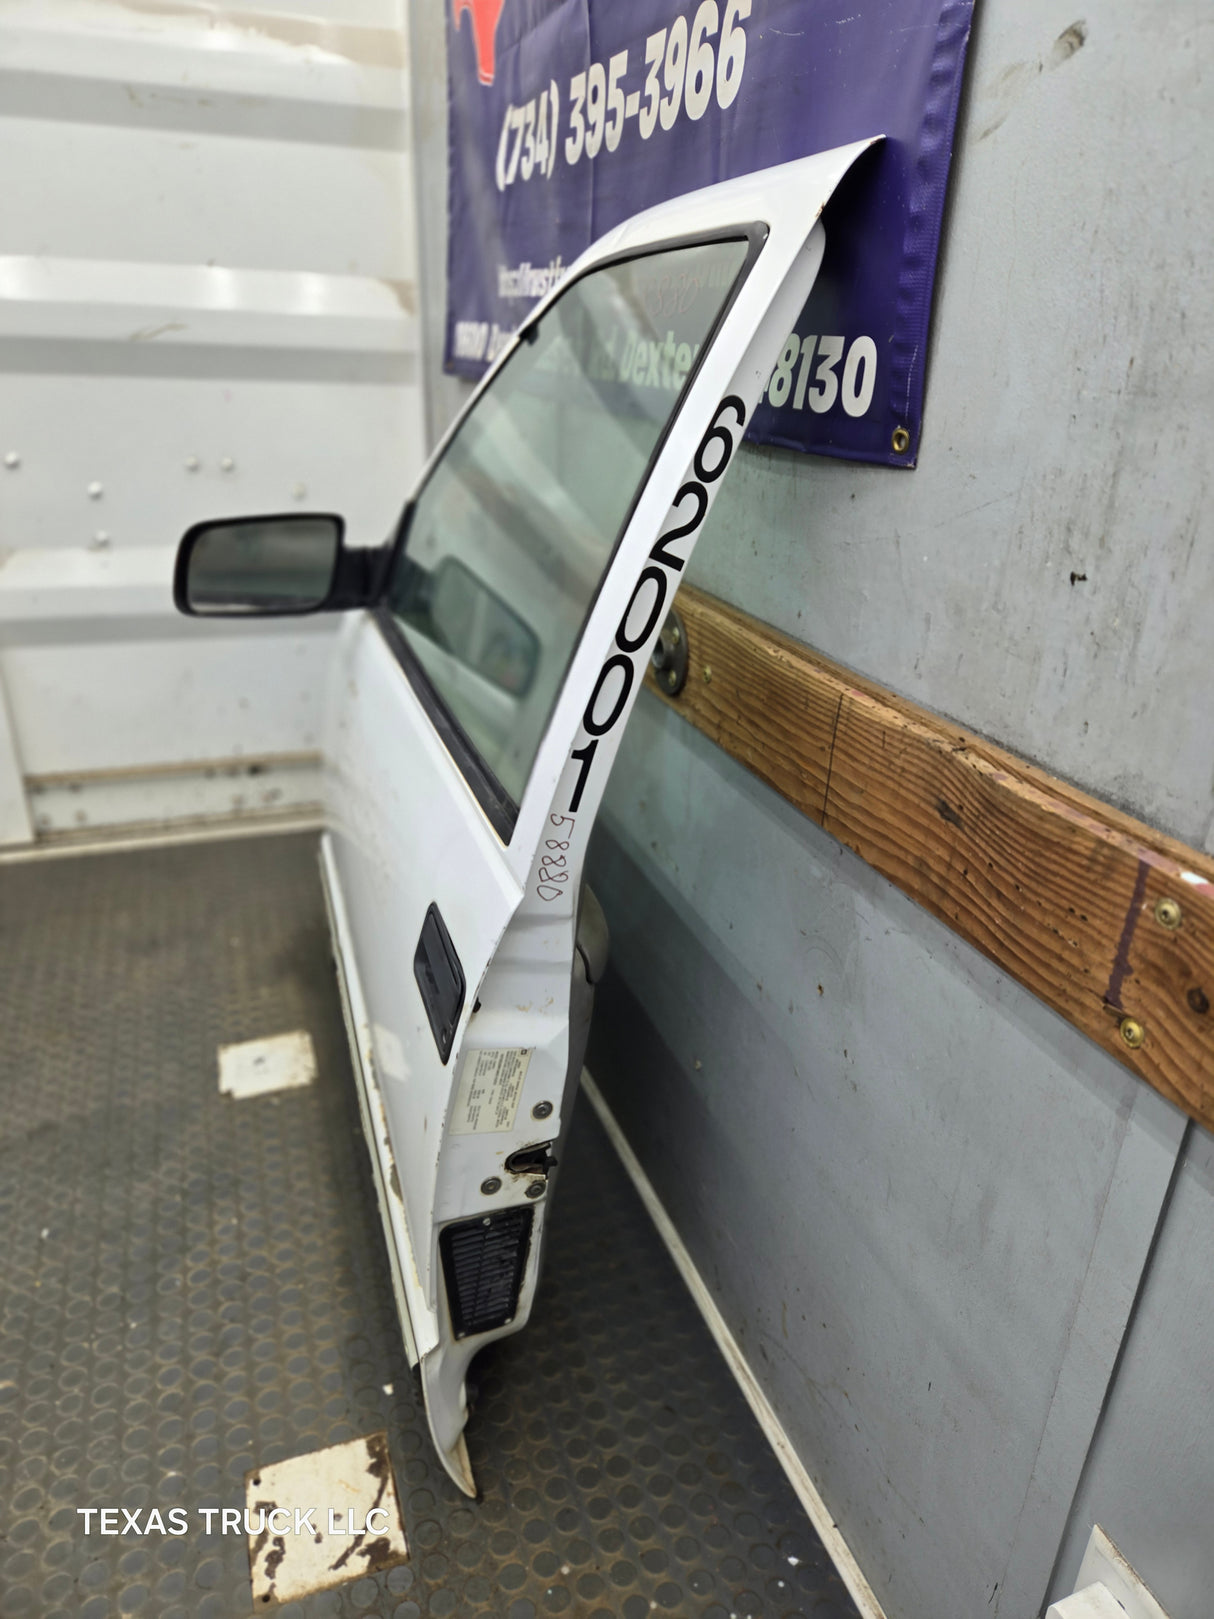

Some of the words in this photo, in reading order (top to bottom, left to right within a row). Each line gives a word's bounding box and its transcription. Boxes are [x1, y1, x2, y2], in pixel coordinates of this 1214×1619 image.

[496, 79, 559, 192] (734)
[565, 0, 752, 165] 395-3966
[757, 333, 878, 418] 8130
[568, 395, 747, 813] 62001
